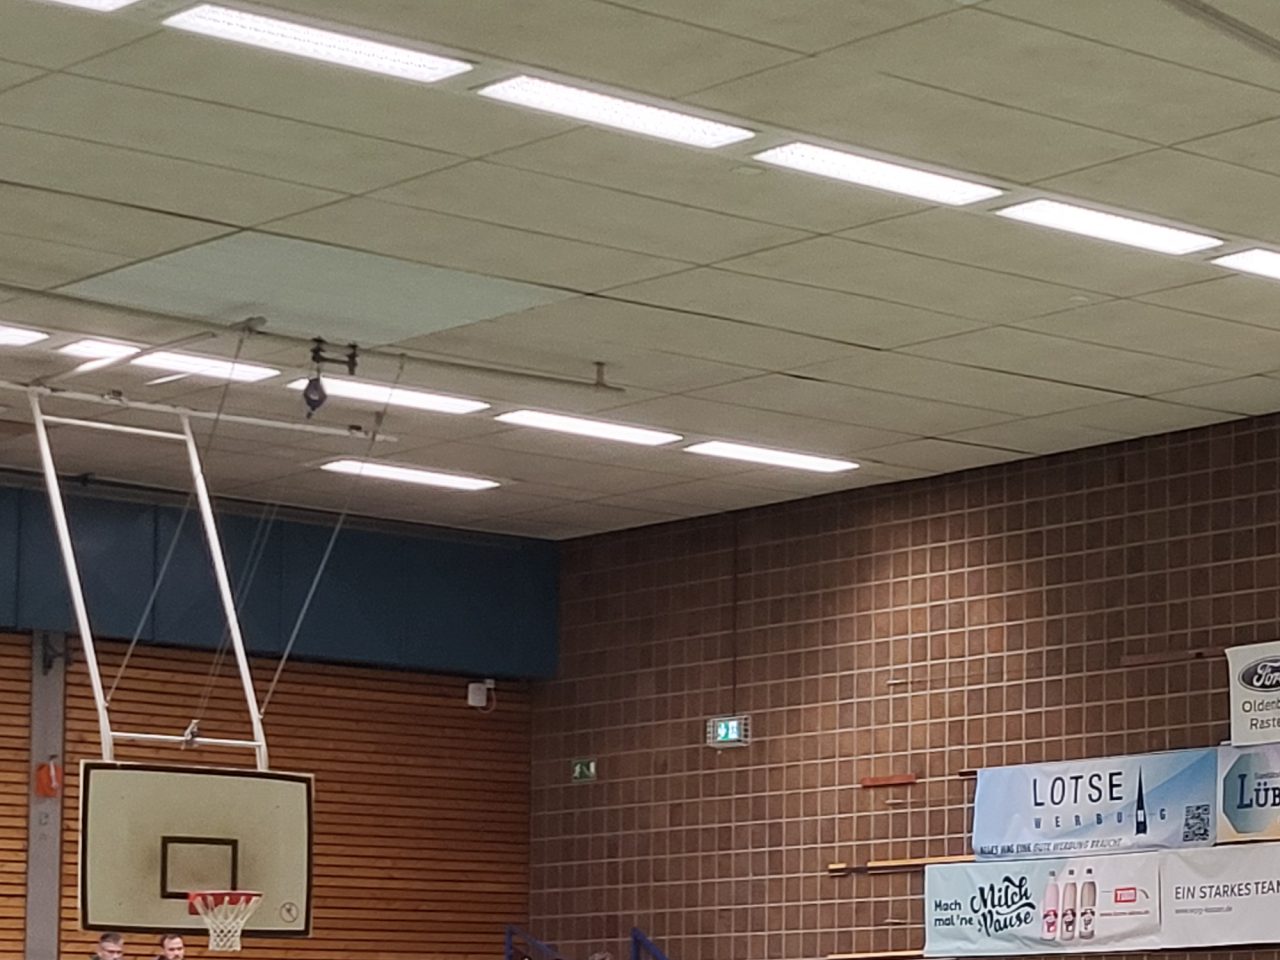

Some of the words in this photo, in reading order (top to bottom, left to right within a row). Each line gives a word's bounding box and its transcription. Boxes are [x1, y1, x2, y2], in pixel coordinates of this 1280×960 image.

[1033, 771, 1123, 807] LOTSE
[970, 876, 1032, 914] Milch
[1175, 886, 1196, 900] EIN
[1199, 883, 1251, 899] STARKES
[934, 900, 962, 912] Mach
[934, 915, 955, 927] mal
